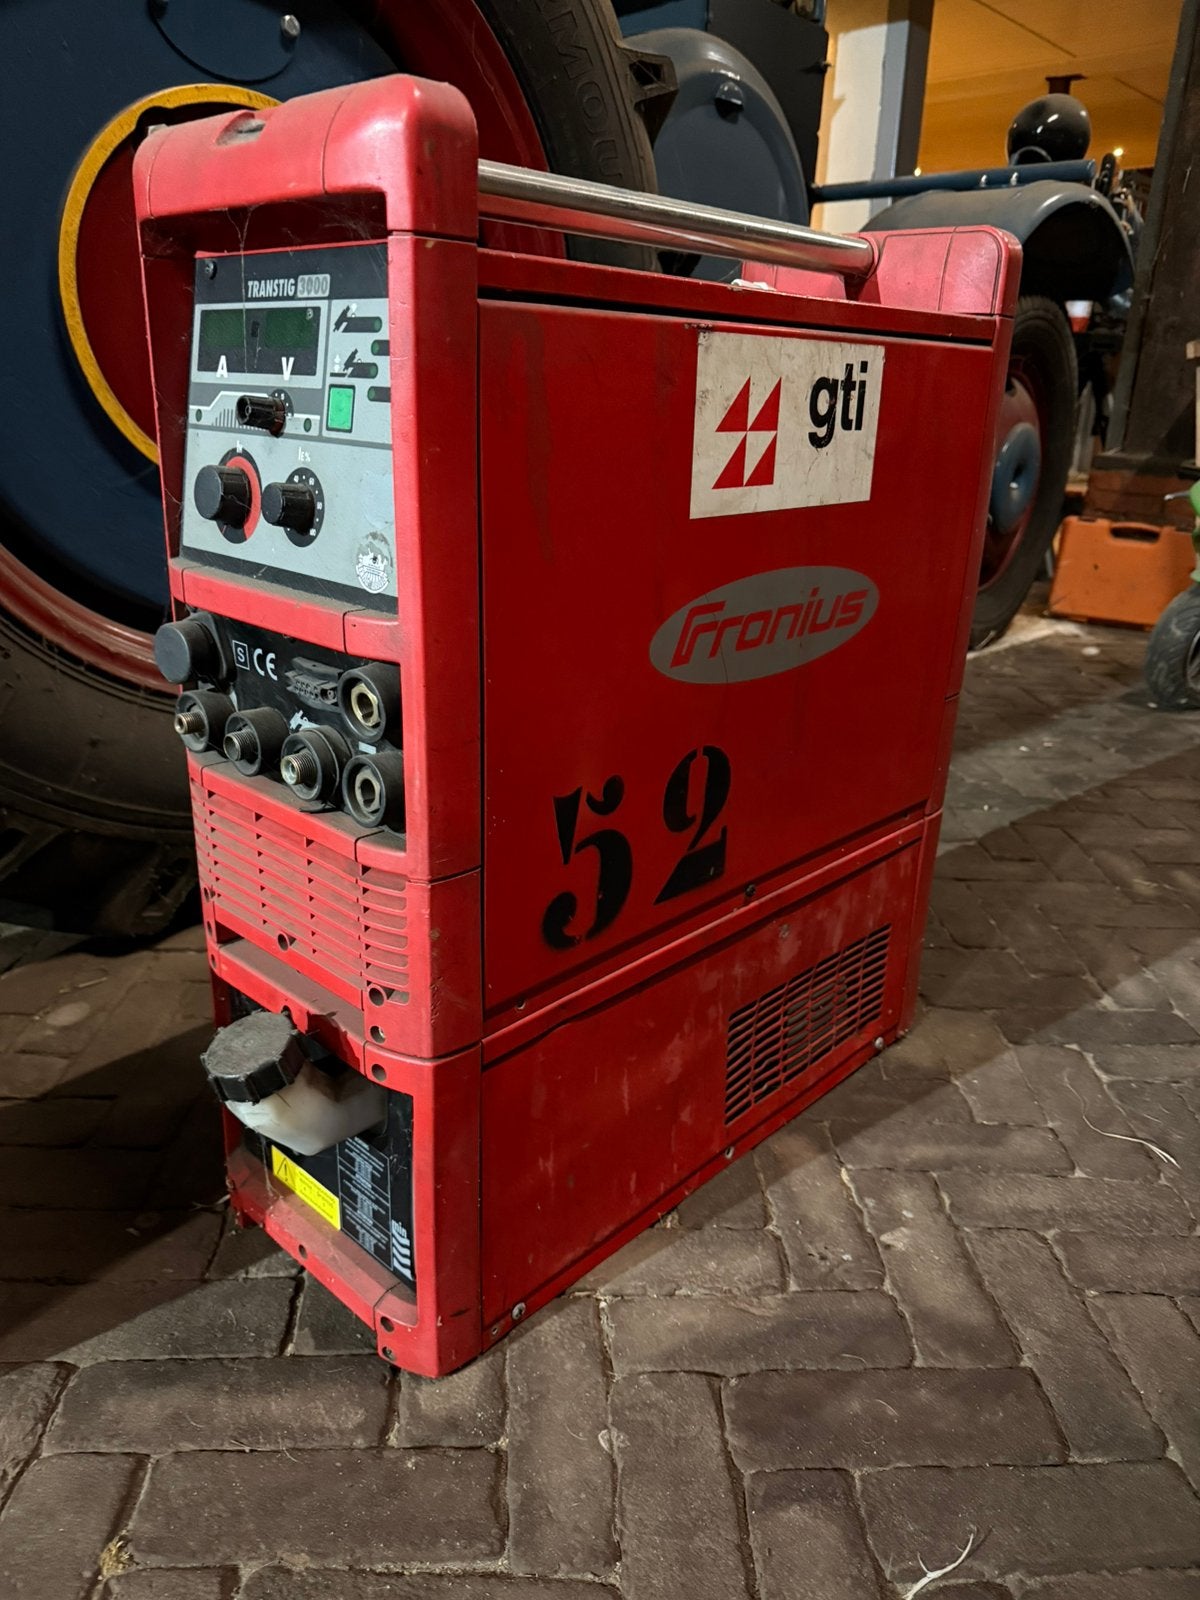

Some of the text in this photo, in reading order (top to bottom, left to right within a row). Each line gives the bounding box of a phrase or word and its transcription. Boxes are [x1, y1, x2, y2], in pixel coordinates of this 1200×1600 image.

[247, 275, 330, 298] TRANSTIG 3000
[216, 355, 295, 381] A V
[807, 361, 868, 449] gti
[670, 586, 869, 668] Fronius
[236, 647, 278, 681] S CE
